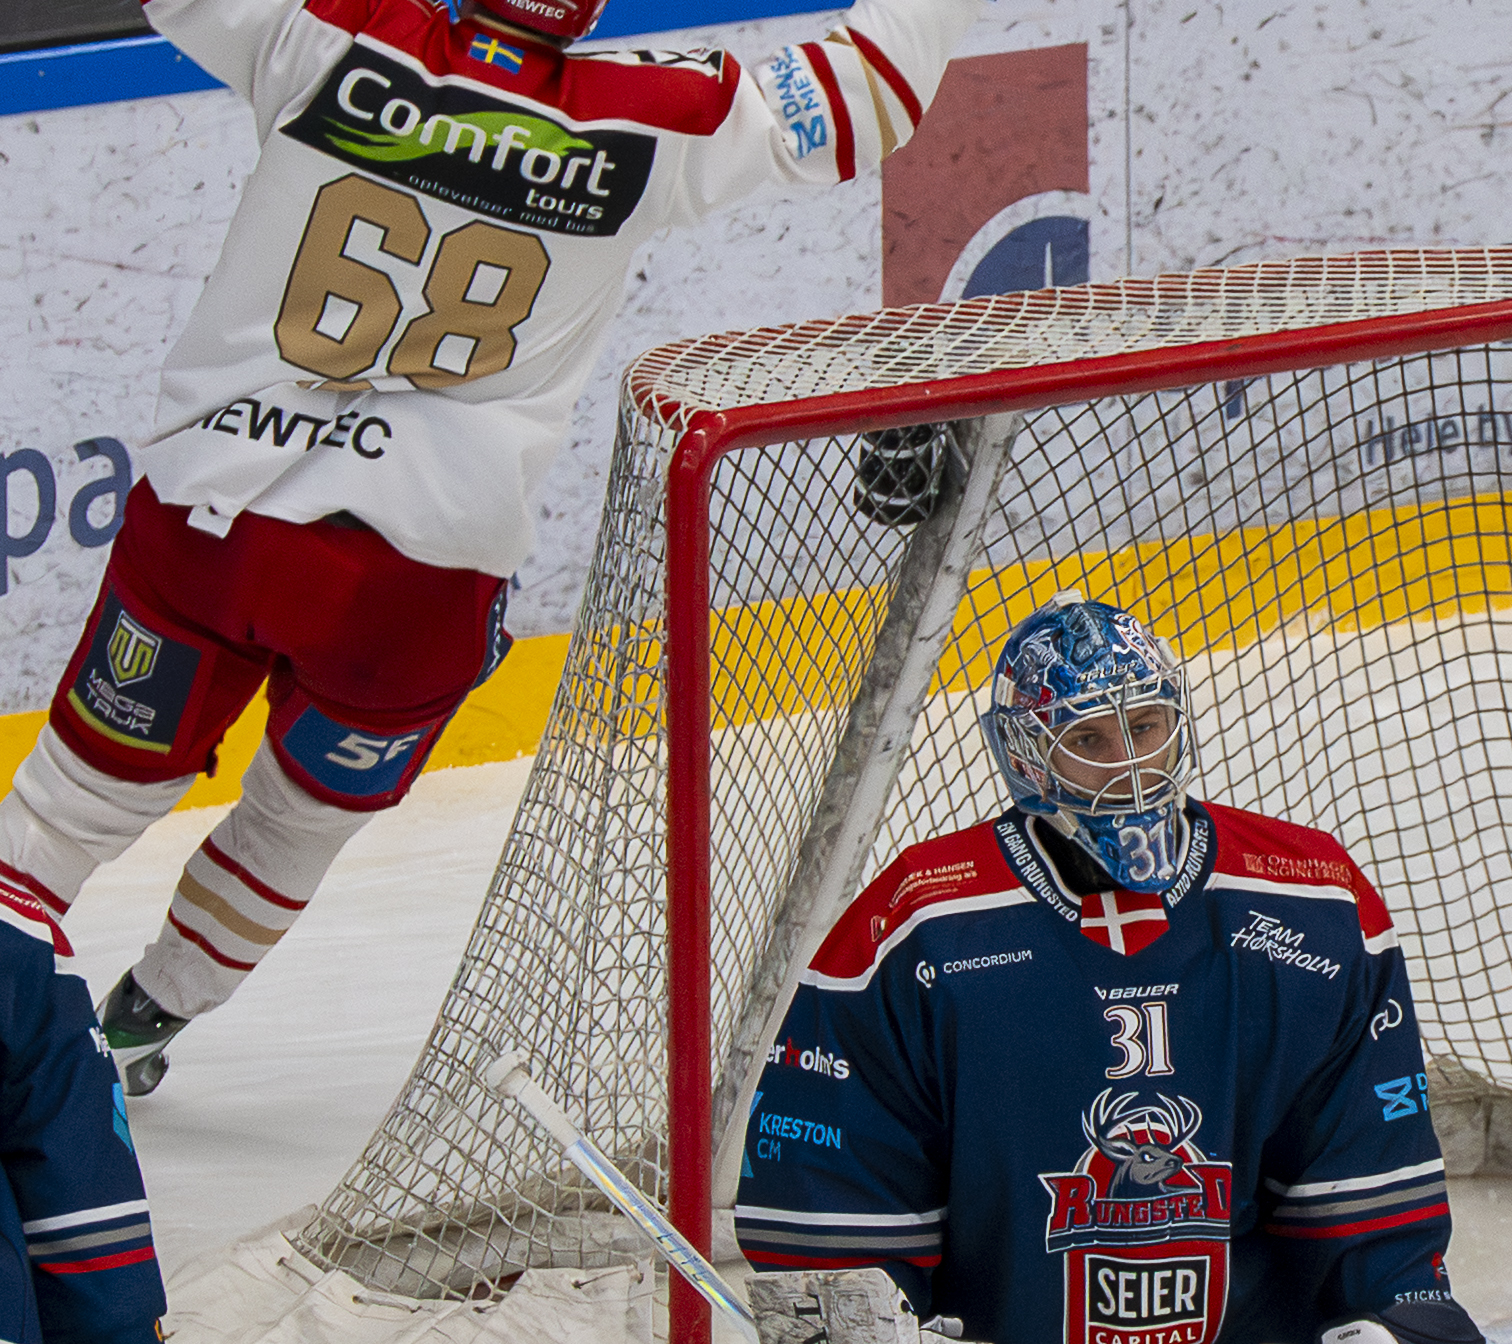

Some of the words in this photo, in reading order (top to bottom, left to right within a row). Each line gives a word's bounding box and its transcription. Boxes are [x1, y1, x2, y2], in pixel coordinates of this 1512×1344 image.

[337, 67, 616, 197] Comfort
[408, 173, 513, 216] oplevelser
[519, 209, 559, 229] med
[526, 188, 605, 221] tours
[274, 172, 552, 390] 68
[996, 821, 1014, 838] EN
[1003, 832, 1032, 868] GANG
[1119, 822, 1177, 883] 31
[1020, 863, 1079, 923] RUNGSTED
[1249, 910, 1305, 947] TEAM
[943, 949, 1034, 975] CONCORDIUM
[1231, 929, 1341, 980] HØRSHOLM
[1109, 983, 1180, 1000] BAUER
[1104, 1001, 1175, 1080] 31
[757, 1138, 782, 1162] CM
[759, 1112, 842, 1149] KRESTON
[1038, 1162, 1233, 1234] RUNGSTED
[1097, 1267, 1198, 1321] SEIER
[1394, 1290, 1443, 1305] STICKS
